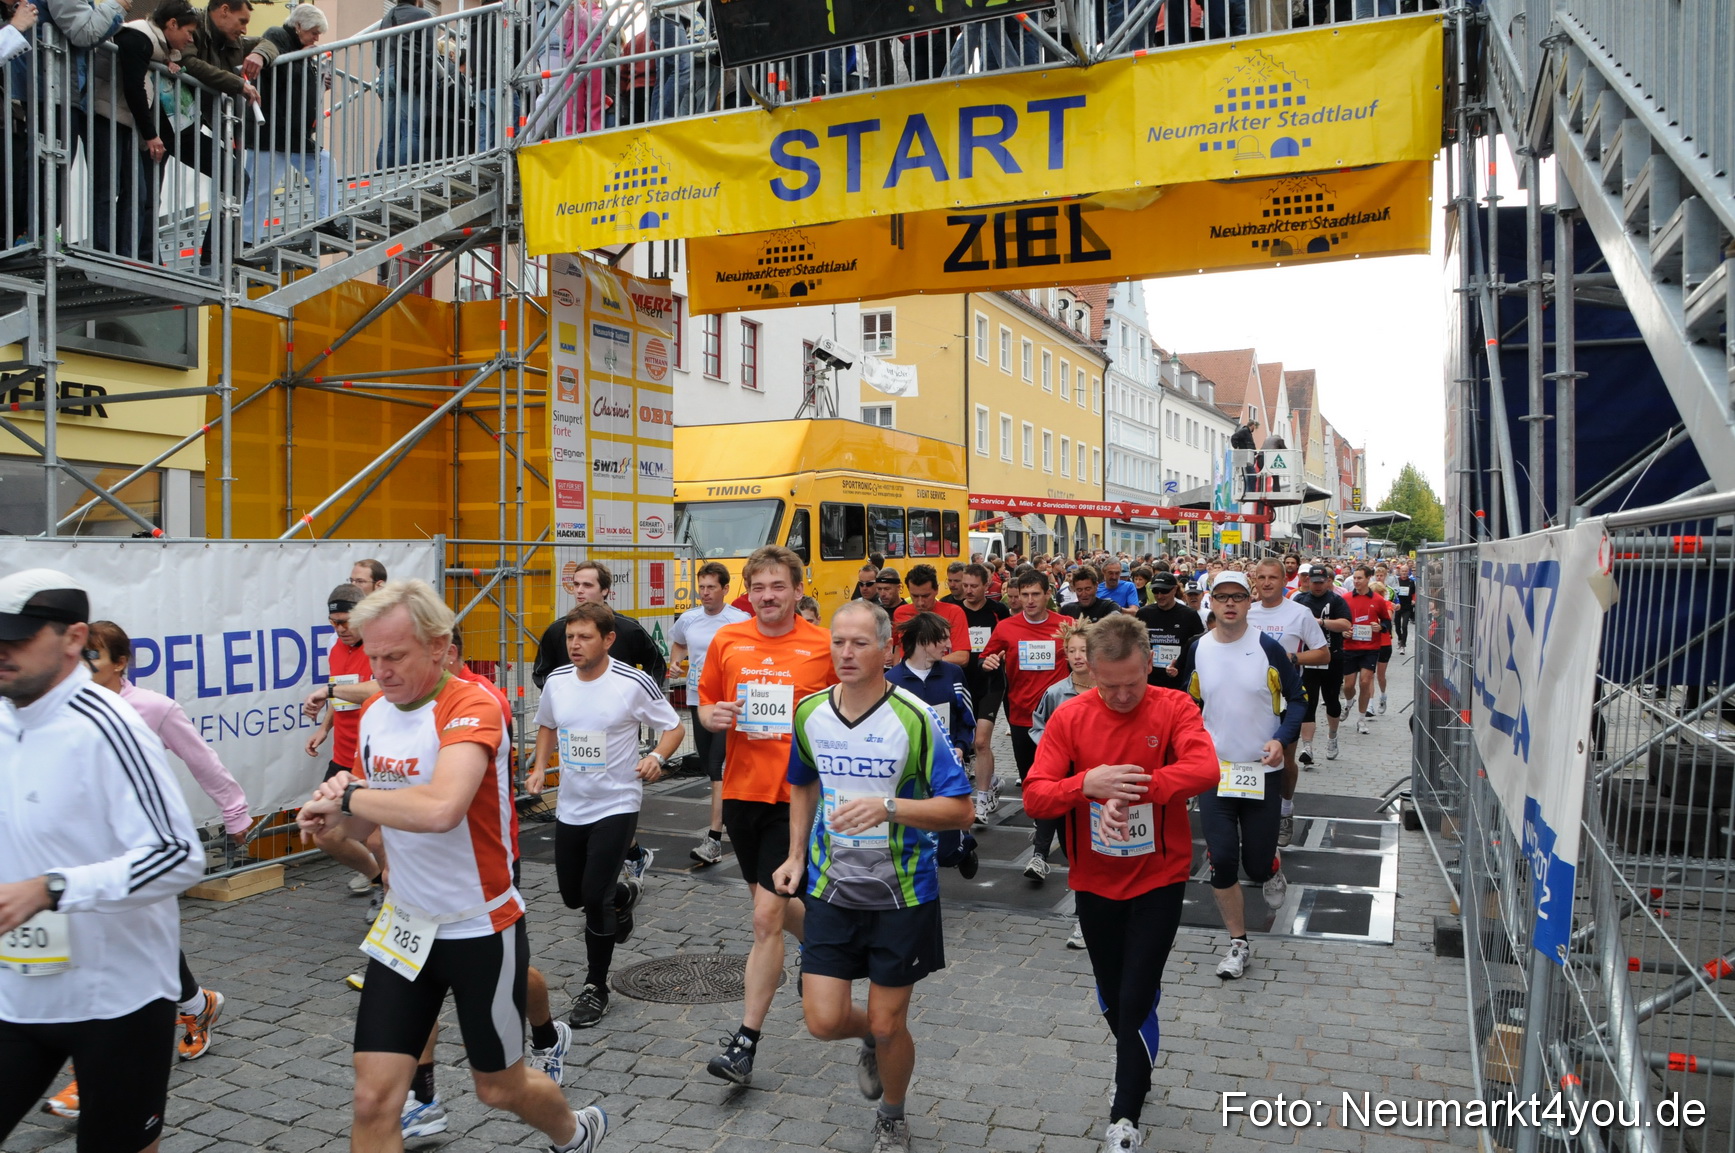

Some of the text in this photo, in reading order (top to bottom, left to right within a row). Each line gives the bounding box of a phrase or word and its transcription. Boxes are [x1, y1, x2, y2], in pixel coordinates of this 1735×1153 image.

[1147, 99, 1379, 142] Neumarkter Stadtlauf
[769, 95, 1087, 202] START
[556, 182, 721, 217] Neumarkter Stadtlauf
[1209, 207, 1391, 239] Neumarkter Stadtlauf
[943, 203, 1112, 273] ZIEL
[715, 257, 858, 283] Neumarkter Stadtlauf
[632, 293, 673, 313] MERZ
[644, 356, 668, 367] WITTMANN
[0, 373, 109, 419] EBER
[553, 410, 583, 426] Sinupret
[639, 406, 674, 426] OBI
[553, 425, 572, 438] forte
[639, 460, 663, 476] MCM
[706, 485, 762, 496] TIMING
[842, 480, 873, 491] SPORTRONIC
[916, 489, 946, 501] EVENT SERVICE
[980, 497, 1005, 505] Service
[1018, 500, 1036, 508] Miet-
[1042, 501, 1078, 510] Serviceline:
[1078, 503, 1096, 511] 09181
[1096, 504, 1112, 512] 6352
[1183, 511, 1199, 519] 6352
[560, 522, 586, 530] INTERSPORT
[639, 520, 661, 528] GERHART
[556, 529, 586, 539] HACKNER
[618, 526, 632, 535] BÖGL
[974, 637, 984, 645] 23
[1029, 651, 1052, 660] 2369
[129, 624, 337, 702] PFLEIDE
[741, 667, 792, 678] SportScheck
[750, 688, 770, 698] klaus
[751, 702, 787, 716] 3004
[570, 733, 588, 743] Bernd
[815, 739, 848, 750] TEAM
[571, 745, 601, 758] 3065
[816, 754, 897, 778] BOCK
[1231, 763, 1254, 773] Jürgen
[1235, 774, 1258, 787] 223
[393, 925, 422, 954] 285
